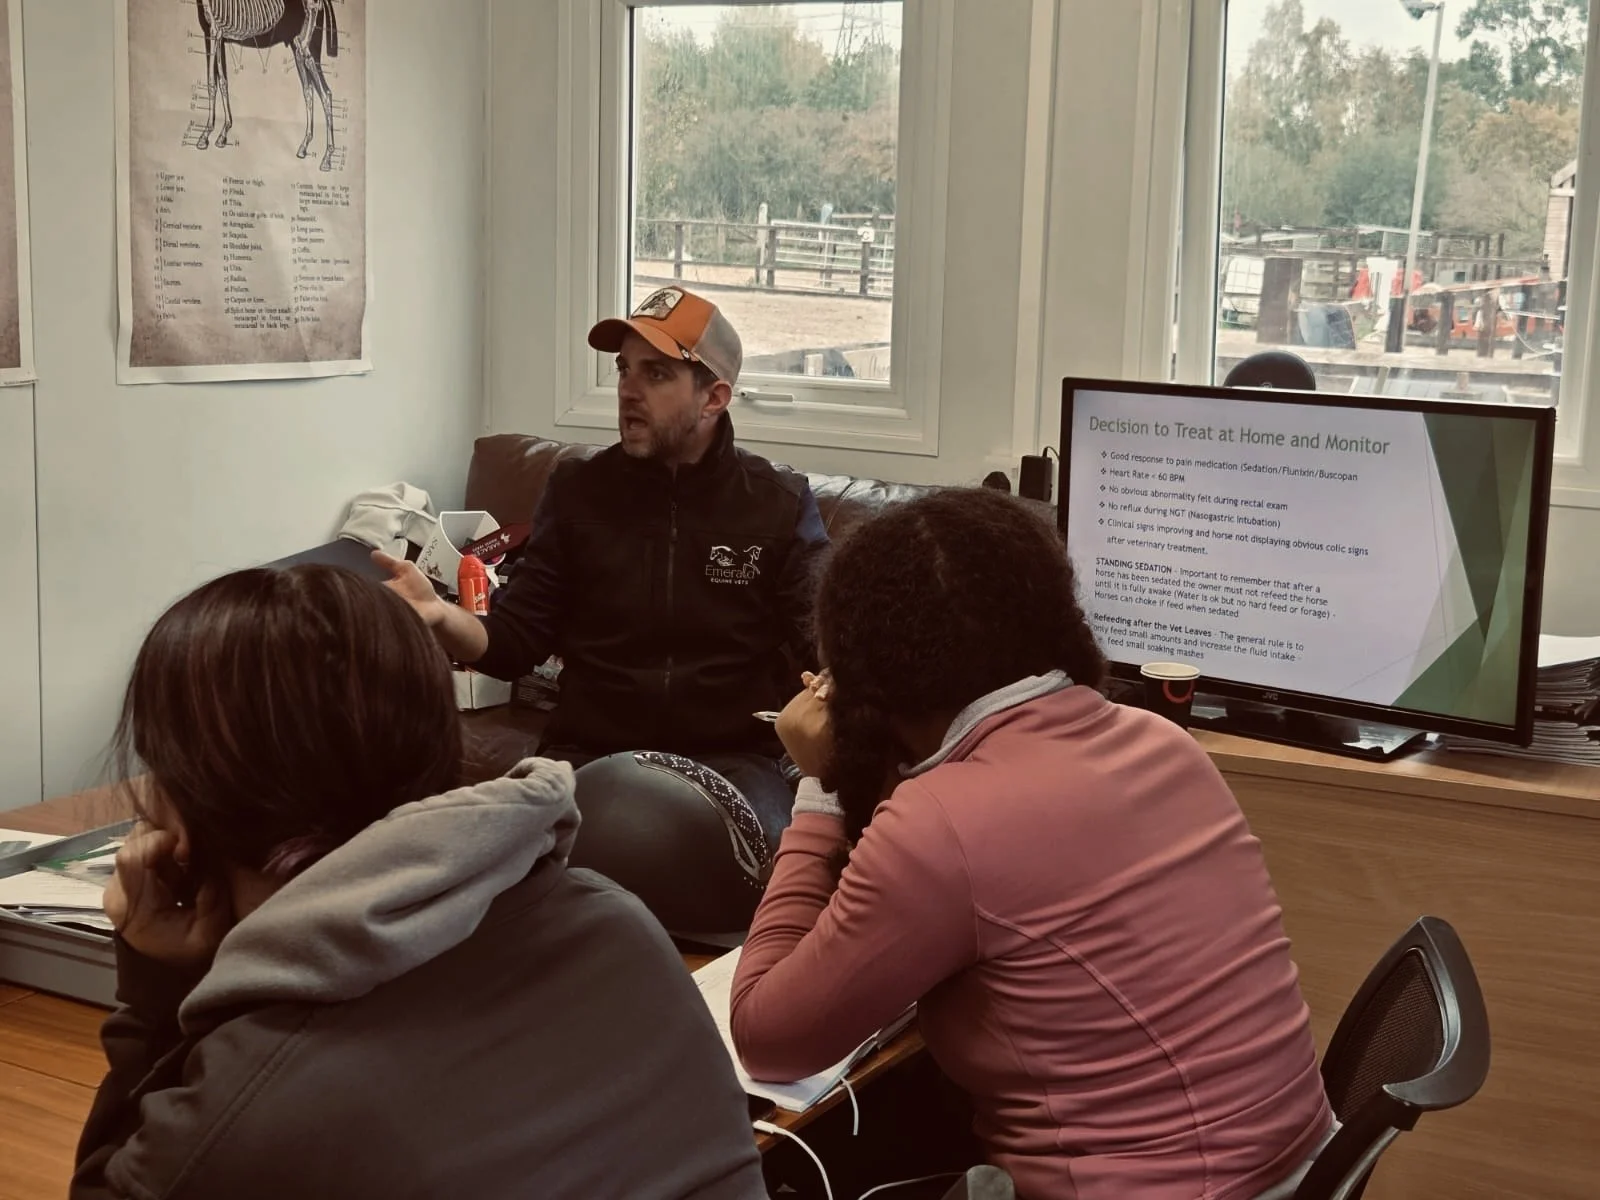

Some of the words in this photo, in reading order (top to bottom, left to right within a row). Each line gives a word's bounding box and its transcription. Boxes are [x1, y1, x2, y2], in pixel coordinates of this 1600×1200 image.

[1089, 416, 1148, 435] Decision
[1154, 423, 1169, 437] to
[1174, 422, 1213, 440] Treat
[1218, 428, 1234, 442] at
[1239, 428, 1285, 446] Home
[1290, 433, 1320, 448] and
[1324, 434, 1391, 454] Monitor
[1110, 452, 1130, 461] Good
[1130, 455, 1164, 465] response
[1175, 458, 1192, 467] pain
[1194, 460, 1238, 470] medication
[1110, 468, 1130, 478] Heart
[1132, 470, 1149, 480] Rate
[1157, 472, 1167, 481] 60
[1169, 473, 1185, 482] BPM
[1109, 484, 1118, 493] No
[1120, 486, 1148, 496] obvious
[1150, 489, 1195, 503] abnormality
[1197, 493, 1211, 502] felt
[1213, 495, 1238, 507] during
[1240, 500, 1263, 508] rectal
[1266, 502, 1288, 510] exam
[1108, 502, 1118, 510] No
[1119, 503, 1142, 513] reflux
[1143, 505, 1168, 518] during
[1169, 508, 1186, 517] NGT
[1187, 510, 1234, 522] (Nasogastric
[1106, 536, 1124, 545] after
[1127, 539, 1164, 552] veterinary
[1167, 543, 1208, 554] treatment.
[1107, 518, 1134, 529] Clinical
[1136, 522, 1154, 532] signs
[1156, 524, 1193, 538] improving
[1195, 529, 1210, 537] and
[1211, 530, 1233, 540] horse
[1250, 534, 1291, 548] displaying
[1292, 539, 1323, 550] obvious
[1325, 543, 1346, 553] colic
[1347, 546, 1369, 556] signs
[705, 564, 754, 579] Emerald
[1096, 557, 1133, 570] STANDING
[1134, 562, 1172, 574] SEDATION
[1179, 568, 1217, 580] Important
[1219, 573, 1228, 581] to
[1230, 576, 1271, 587] remember
[1273, 580, 1290, 589] that
[1292, 582, 1313, 592] after
[1095, 567, 1115, 578] horse
[1116, 570, 1129, 579] has
[1130, 572, 1149, 582] been
[1151, 576, 1180, 586] sedated
[1182, 579, 1195, 588] the
[1197, 583, 1221, 591] owner
[1223, 586, 1242, 594] must
[1260, 590, 1287, 600] refeed
[1289, 593, 1303, 602] the
[1305, 595, 1328, 606] horse
[1095, 580, 1111, 588] until
[1113, 581, 1119, 590] it
[1128, 583, 1146, 595] fully
[1148, 588, 1172, 596] awake
[1173, 589, 1199, 600] (Water
[1209, 594, 1219, 603] ok
[1220, 595, 1234, 605] but
[1248, 599, 1267, 609] hard
[1268, 602, 1288, 612] feed
[1300, 606, 1330, 619] forage)
[1094, 590, 1118, 601] Horses
[1134, 596, 1157, 606] choke
[1166, 600, 1184, 610] feed
[1185, 603, 1206, 613] when
[1208, 606, 1239, 617] sedated
[1094, 612, 1132, 627] Refeeding
[1132, 618, 1152, 628] after
[1153, 621, 1167, 630] the
[1169, 623, 1182, 632] Vet
[1184, 625, 1212, 637] Leaves
[1219, 630, 1234, 640] The
[1236, 635, 1265, 645] general
[1268, 639, 1284, 648] rule
[1295, 642, 1304, 650] to
[1110, 626, 1128, 636] feed
[1128, 630, 1148, 639] small
[1149, 634, 1182, 644] amounts
[1183, 638, 1199, 646] and
[1199, 639, 1232, 651] increase
[1233, 644, 1247, 654] the
[1249, 646, 1267, 656] fluid
[1269, 649, 1296, 661] intake
[1107, 637, 1124, 647] feed
[1125, 641, 1145, 650] small
[1146, 644, 1174, 656] soaking
[1176, 649, 1204, 658] mashes
[1262, 692, 1278, 700] JVC
